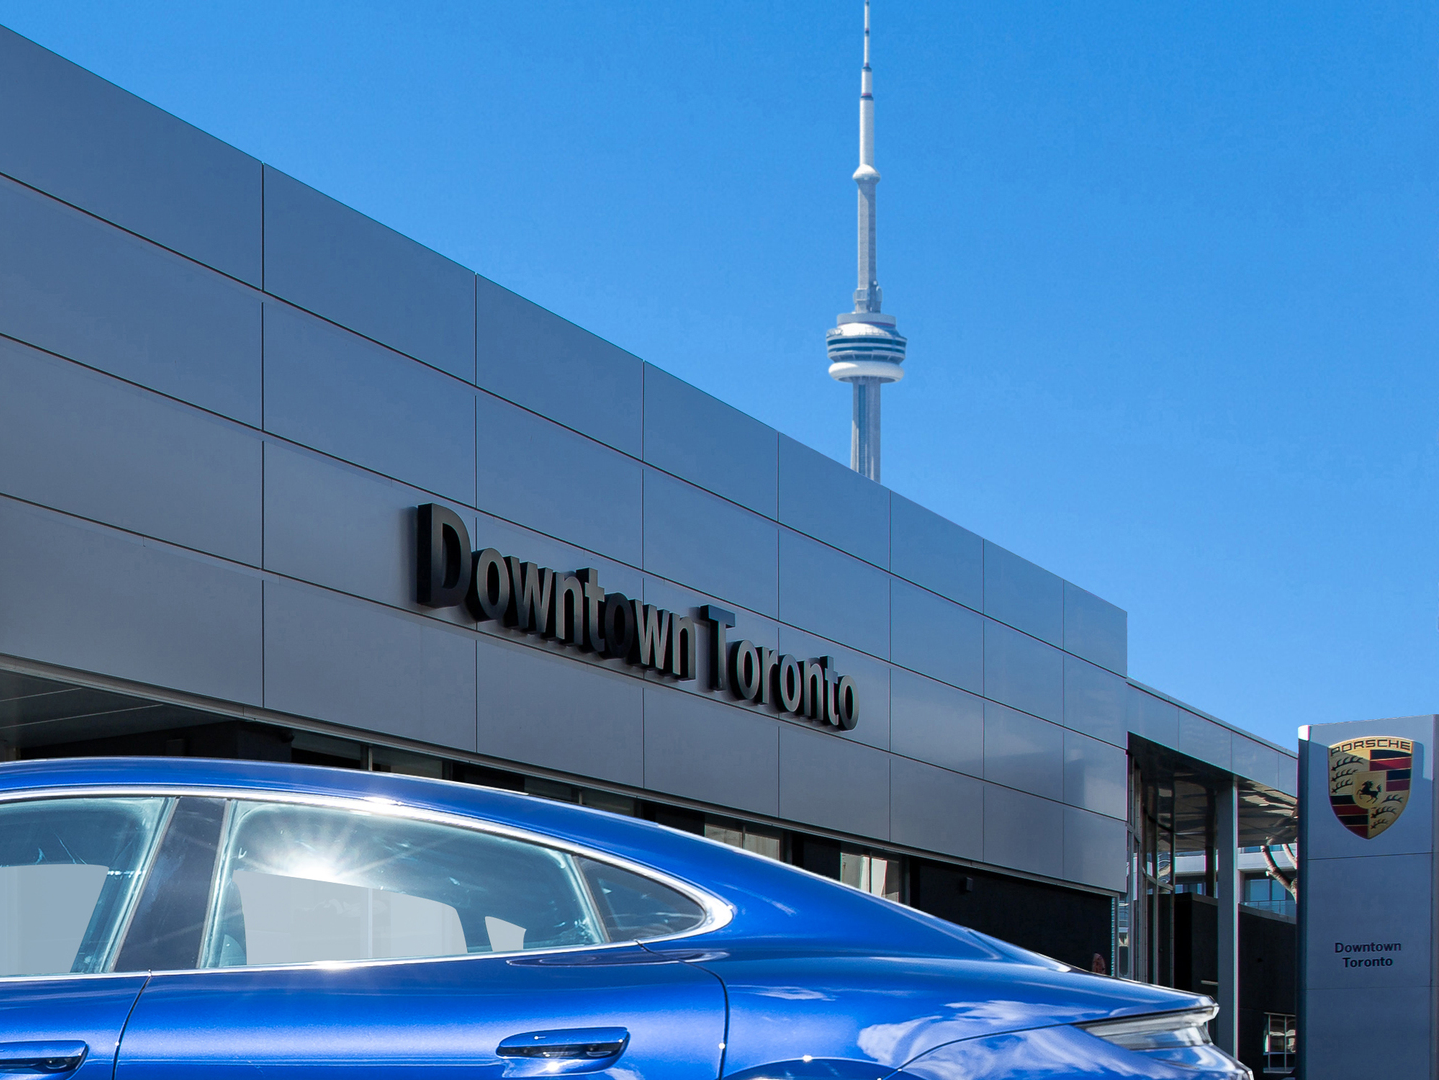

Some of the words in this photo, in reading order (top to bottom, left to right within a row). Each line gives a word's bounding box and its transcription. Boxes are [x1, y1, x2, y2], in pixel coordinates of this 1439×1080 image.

[417, 503, 696, 680] Downtown
[700, 604, 859, 731] Toronto
[1330, 739, 1411, 757] PORSCHE
[1334, 942, 1402, 954] Downtown
[1342, 956, 1394, 968] Toronto
